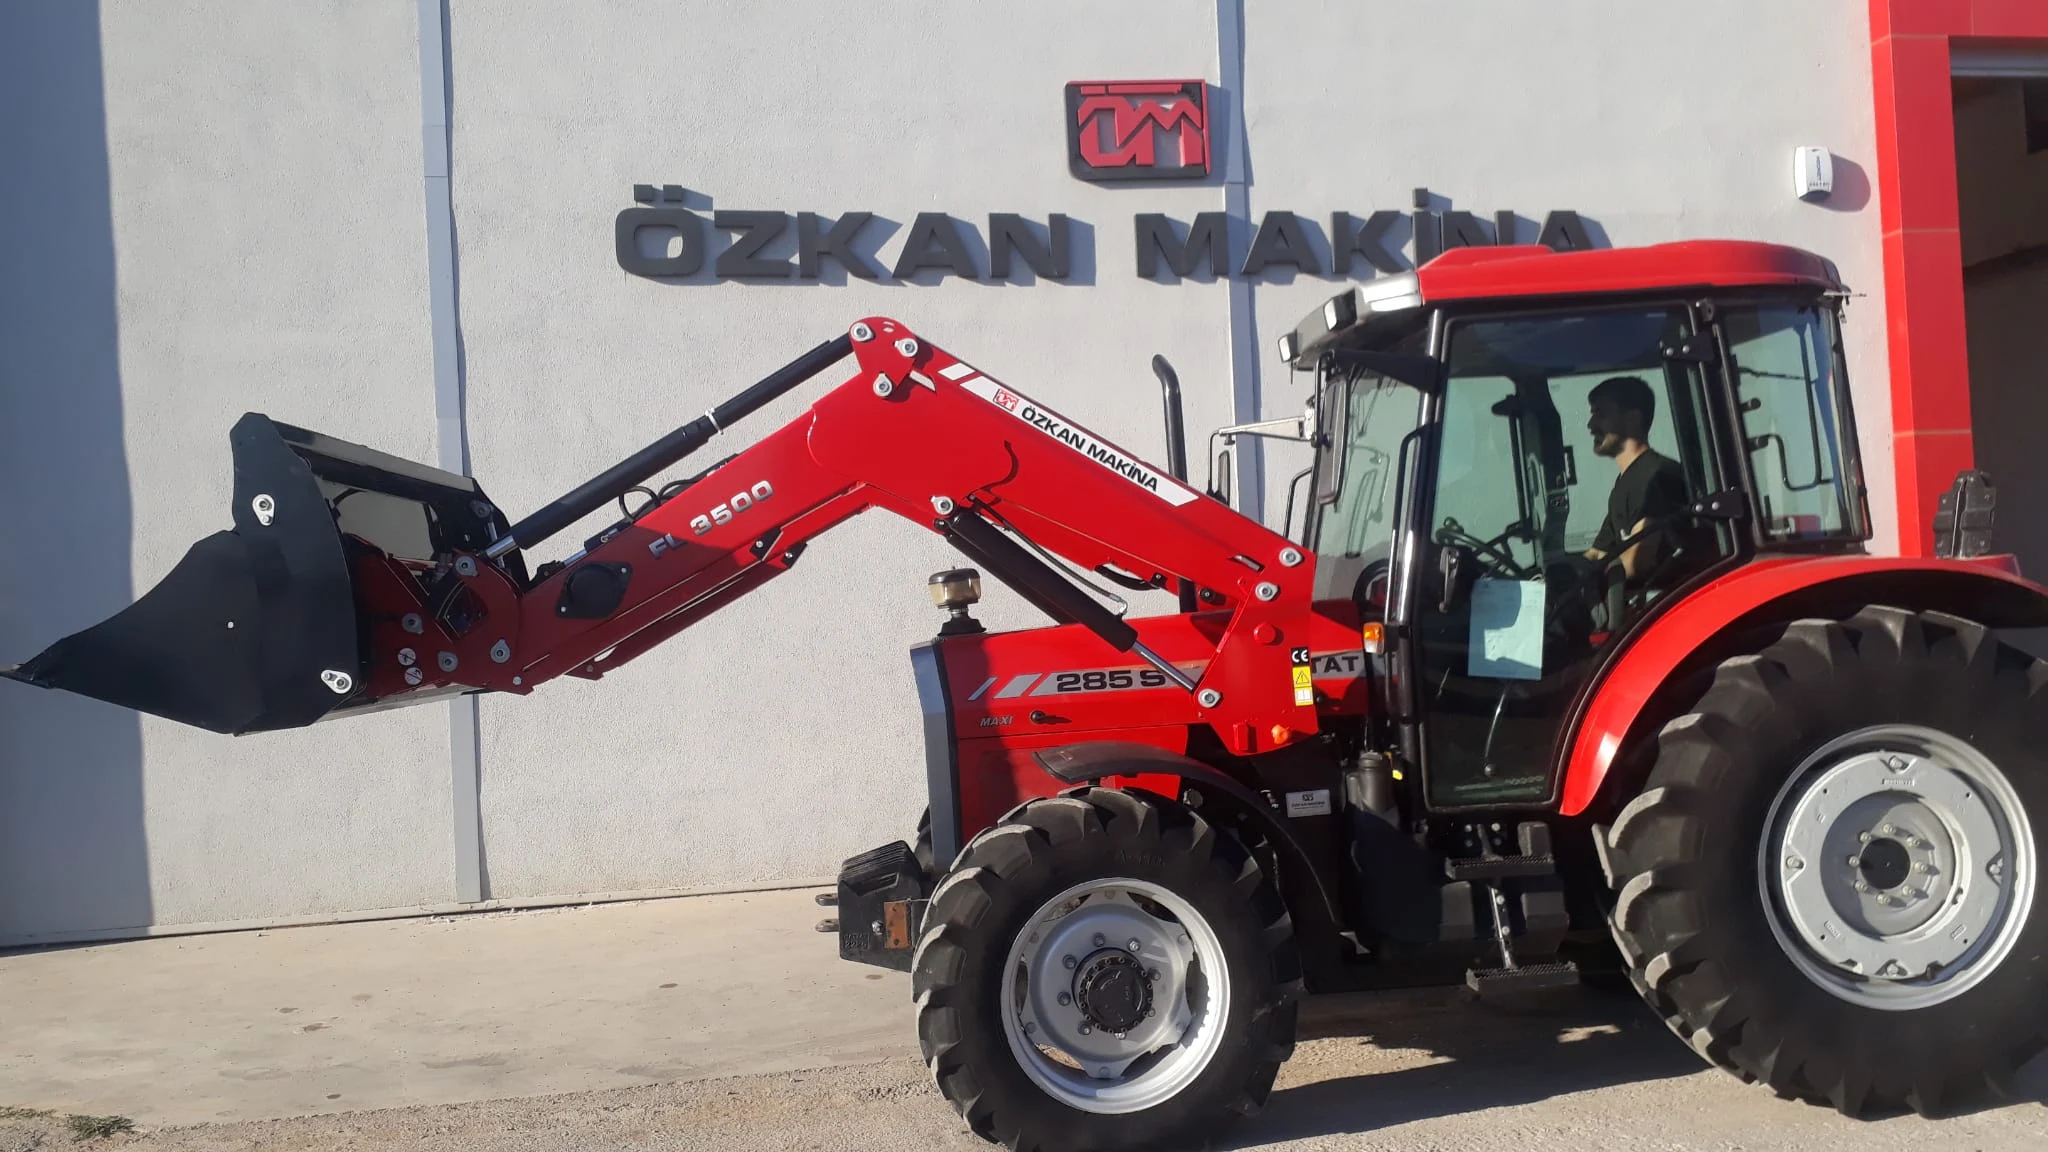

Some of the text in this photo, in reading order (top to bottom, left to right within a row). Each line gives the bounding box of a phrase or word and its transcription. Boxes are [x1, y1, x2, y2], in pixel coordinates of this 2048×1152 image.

[615, 184, 1595, 278] ÖZKAN MAKİNA
[1021, 405, 1159, 492] ÖZKAN MAKİNA
[689, 479, 774, 536] 3500
[1056, 669, 1166, 692] 285 S
[980, 715, 1013, 727] MAXI
